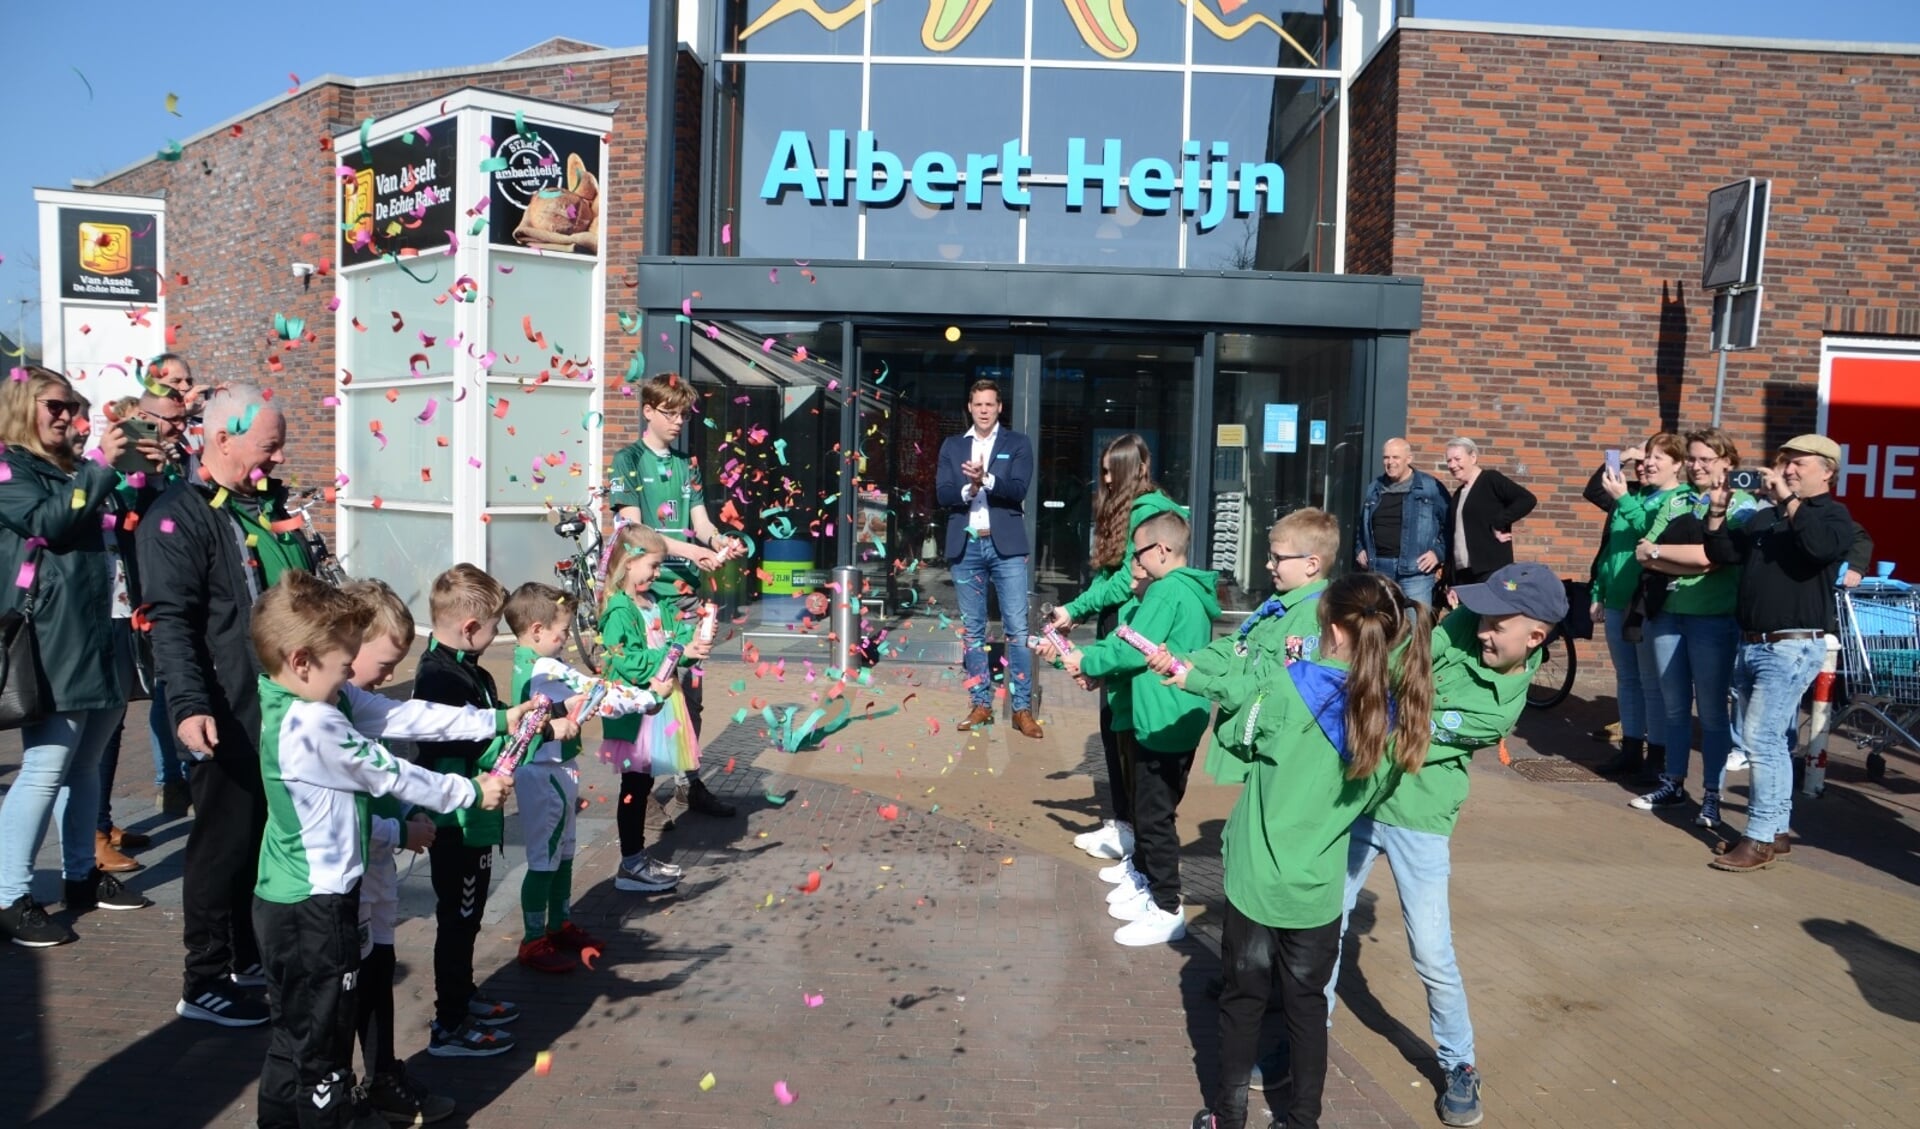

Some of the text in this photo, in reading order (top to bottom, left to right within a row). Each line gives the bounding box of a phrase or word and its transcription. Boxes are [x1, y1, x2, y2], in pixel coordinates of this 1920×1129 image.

[495, 163, 562, 180] ambachtelijk
[759, 129, 1286, 230] Albert Heijn
[376, 174, 399, 196] Van
[521, 177, 540, 187] werk
[375, 202, 389, 221] De
[389, 195, 415, 218] Echte
[72, 283, 141, 295] De Echte Bakker
[79, 274, 134, 287] Van Asselt
[1836, 443, 1920, 499] HE
